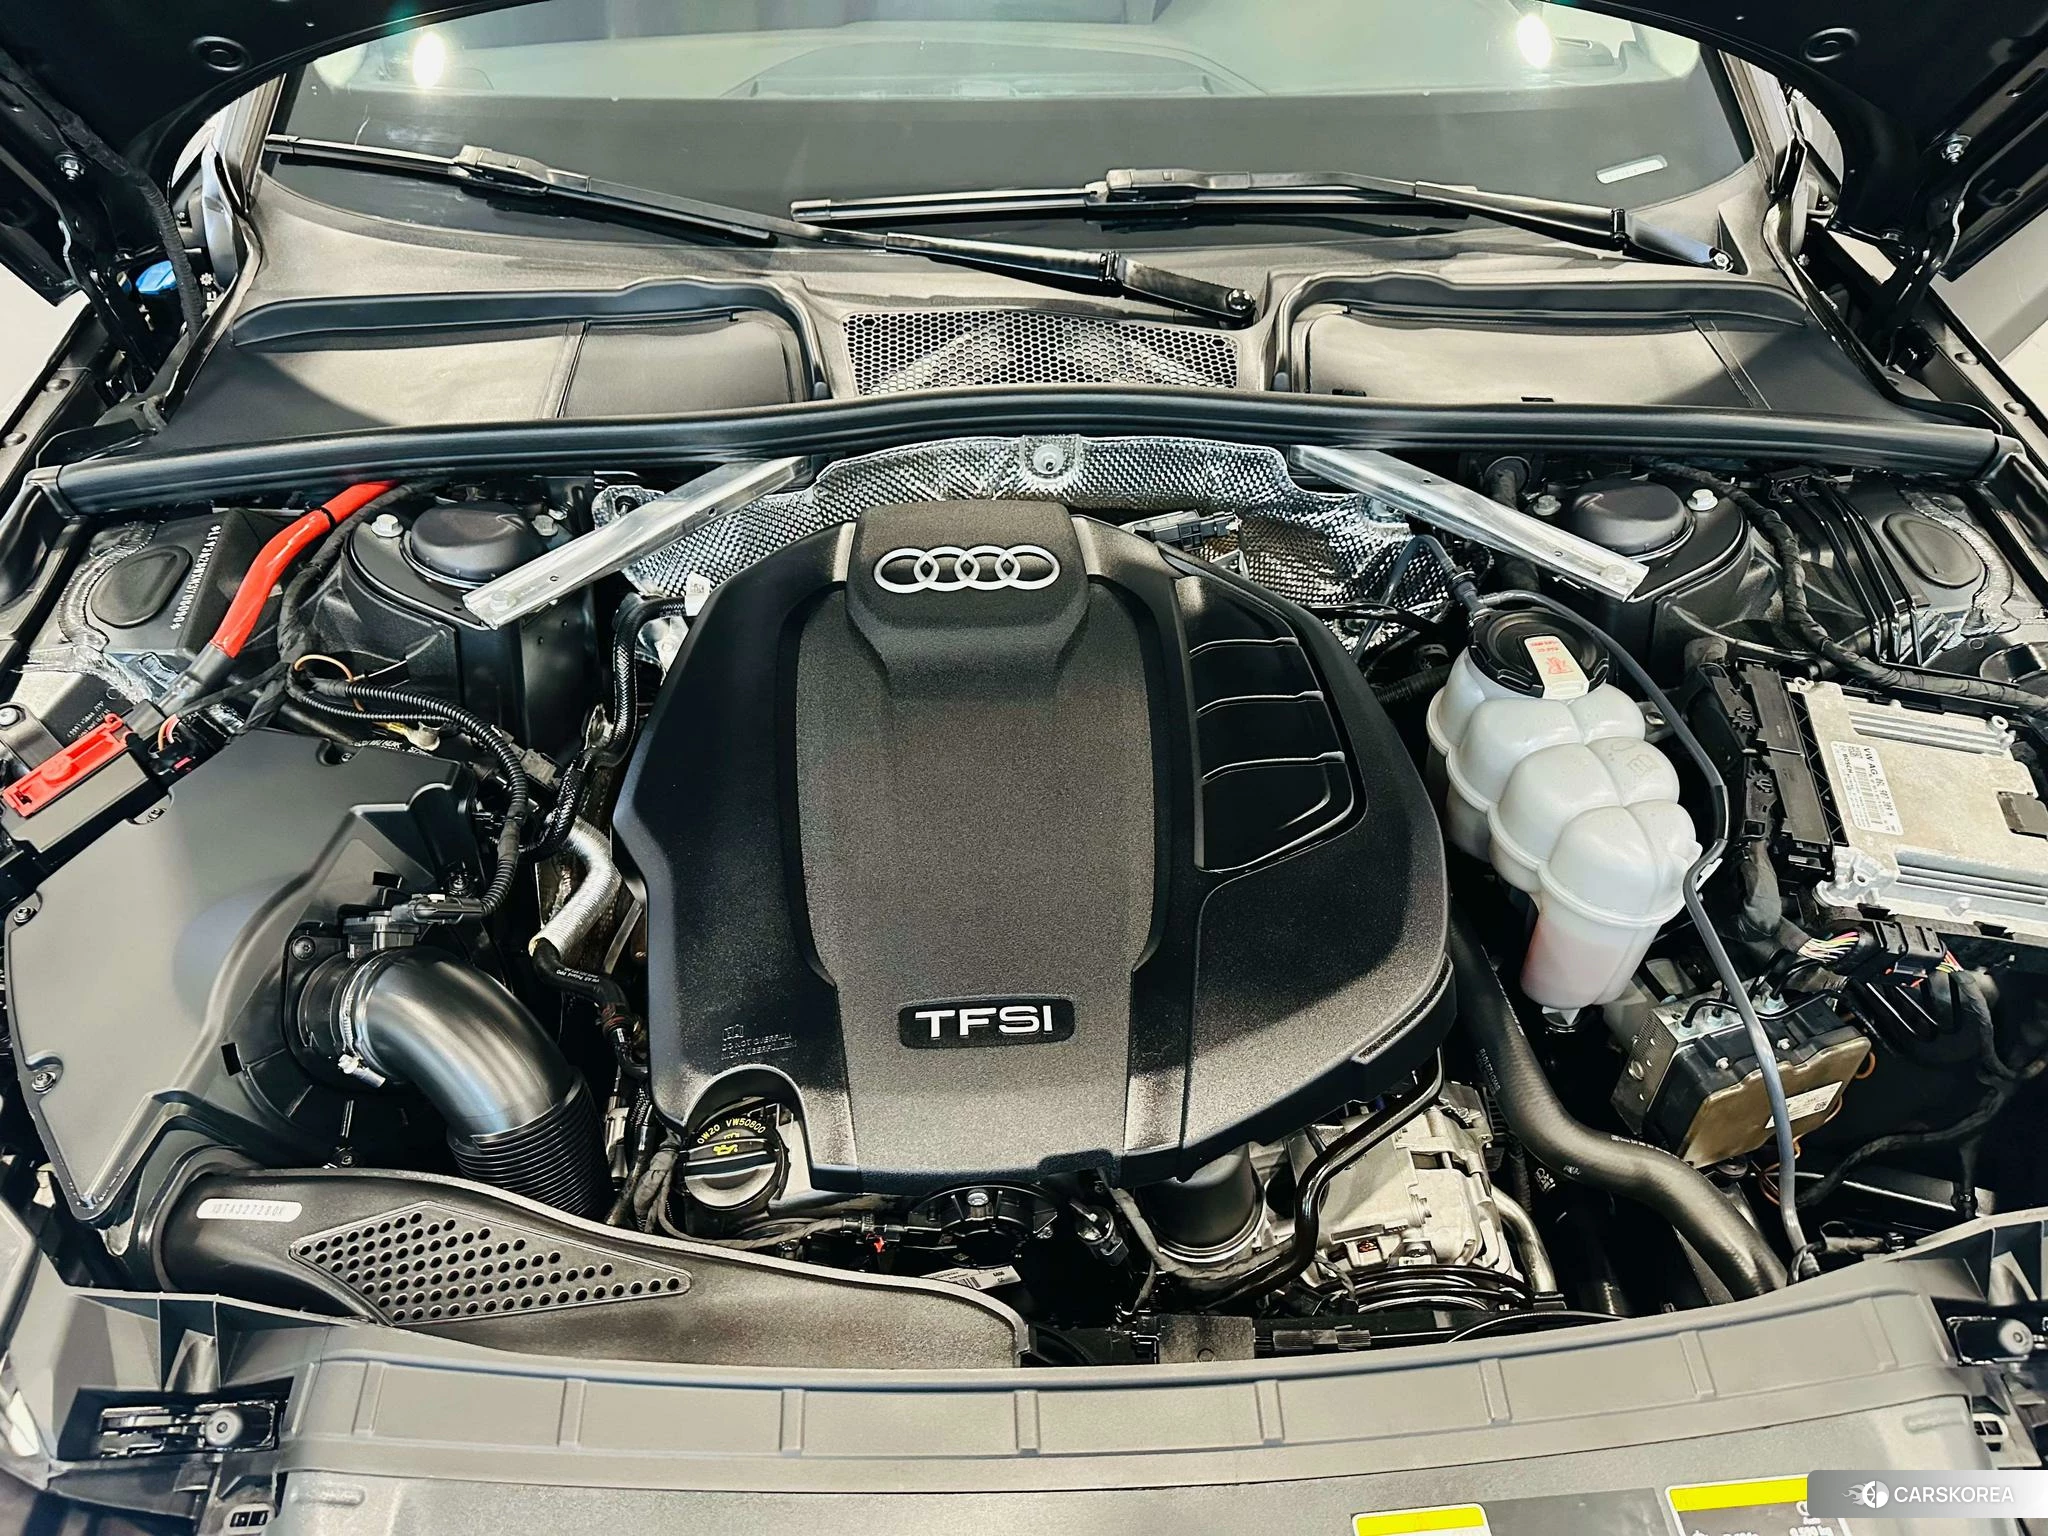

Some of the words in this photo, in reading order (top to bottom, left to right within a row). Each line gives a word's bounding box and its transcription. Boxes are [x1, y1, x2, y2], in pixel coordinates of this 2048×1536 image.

[915, 1005, 1053, 1038] TFSI
[697, 1124, 720, 1144] 0W20
[726, 1117, 766, 1133] VW50800
